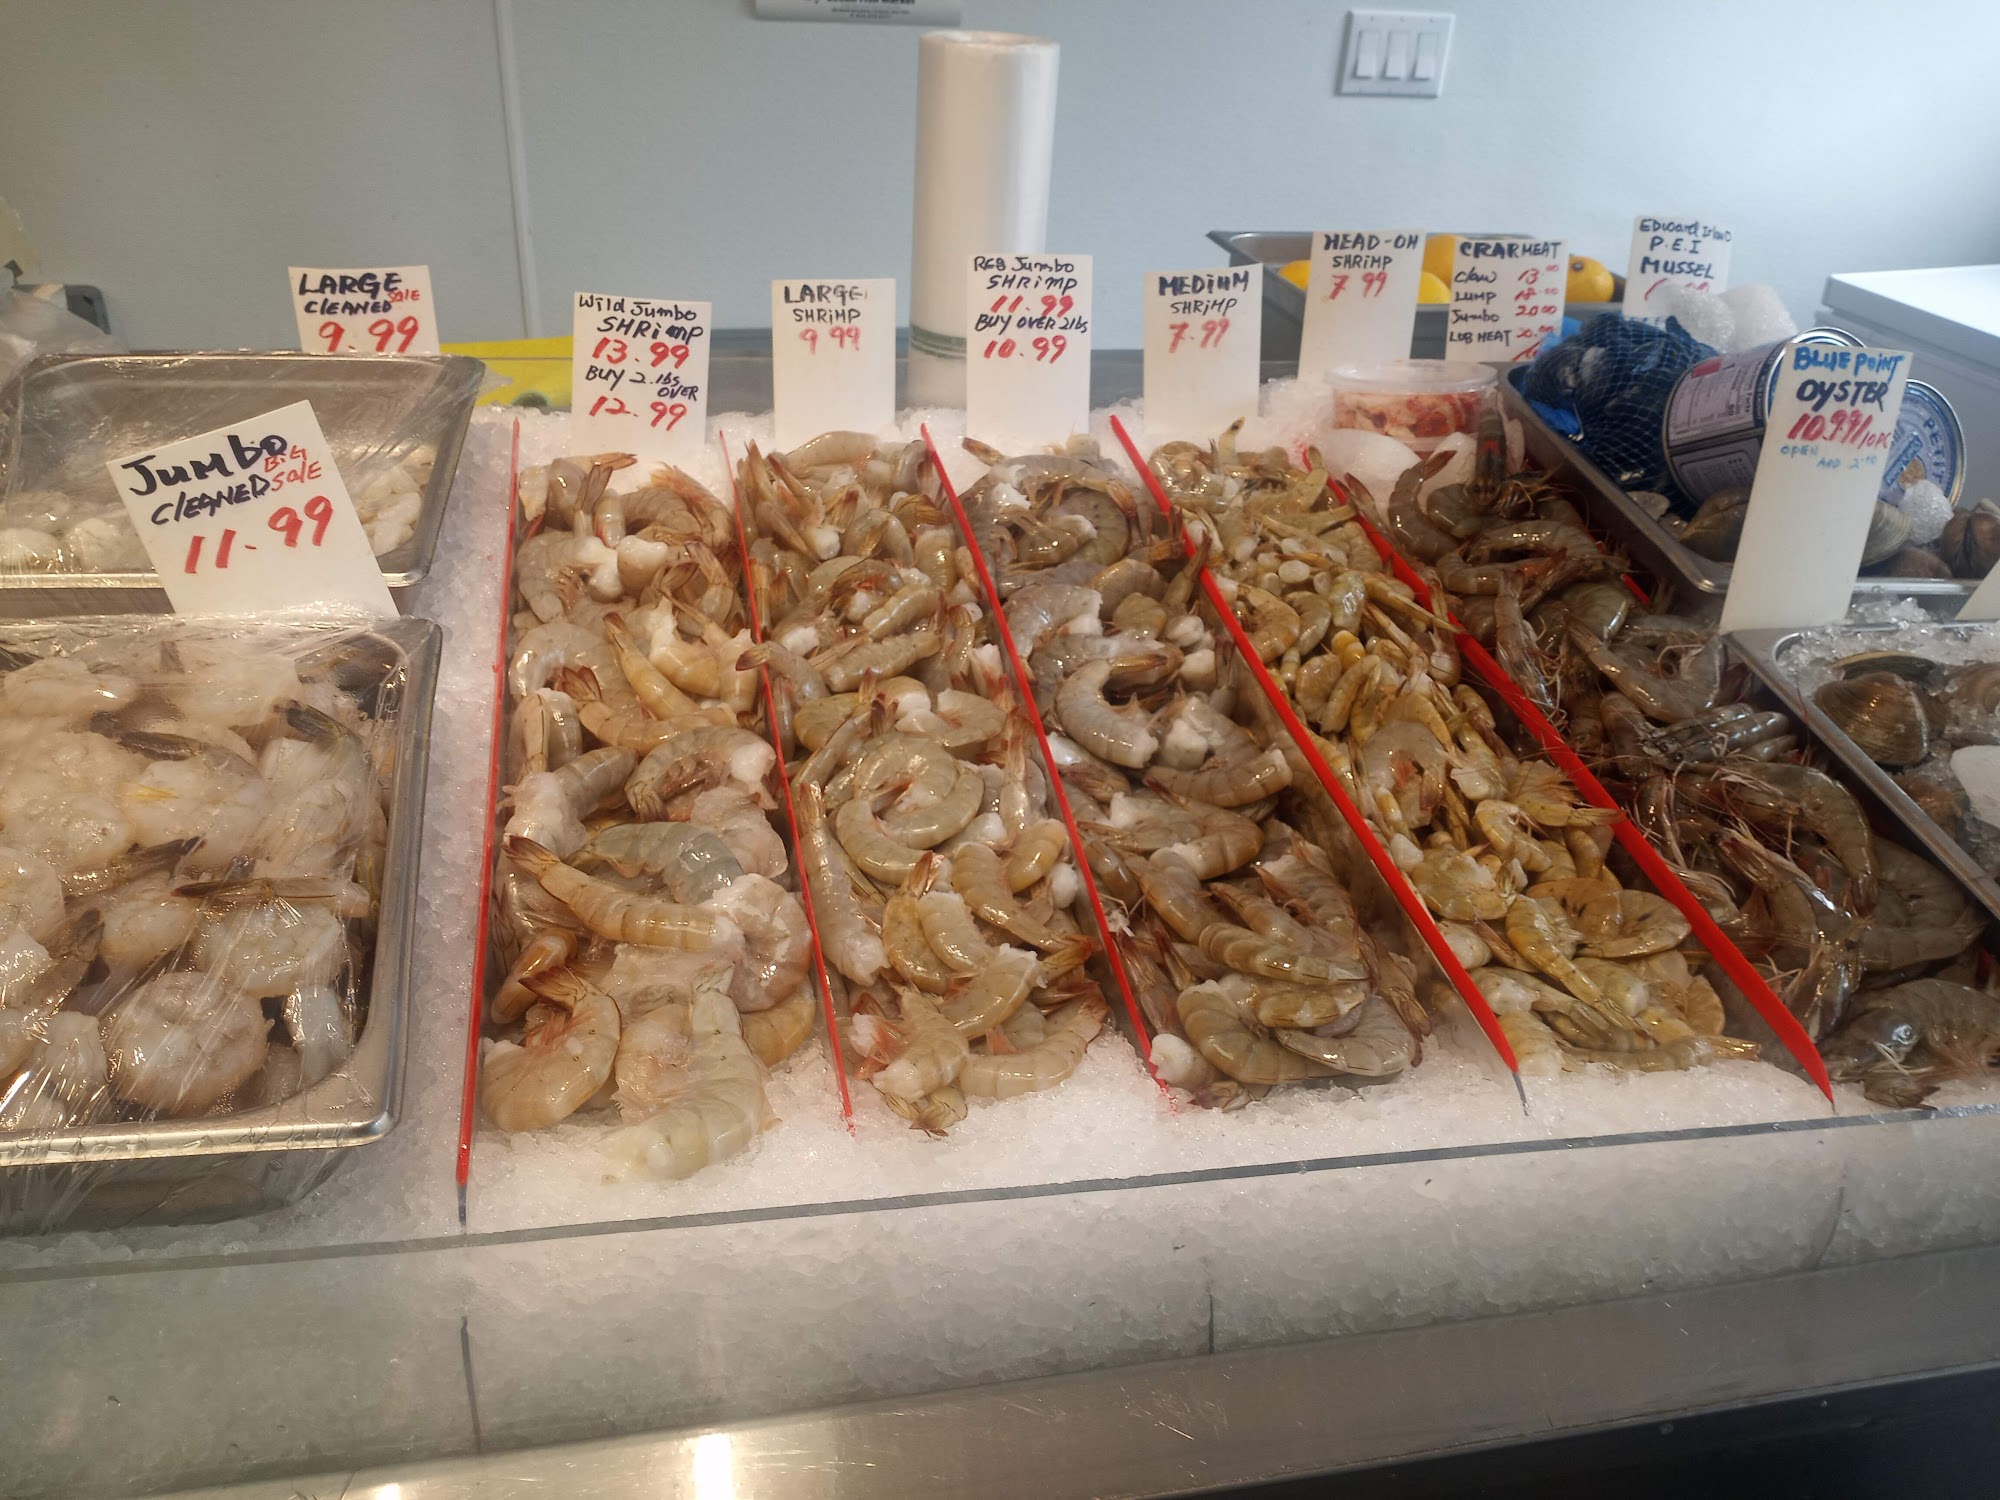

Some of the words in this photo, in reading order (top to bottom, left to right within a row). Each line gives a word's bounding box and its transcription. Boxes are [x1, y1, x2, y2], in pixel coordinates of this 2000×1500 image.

[1011, 257, 1074, 273] Jumbo
[1640, 256, 1714, 279] MUSSEL
[299, 273, 402, 299] LARGE
[784, 284, 864, 306] LARGE
[631, 302, 697, 321] Jumbo
[990, 295, 1074, 318] 11.99
[319, 316, 418, 352] 9.99
[974, 314, 1012, 335] BUY
[1017, 316, 1056, 331] OVER
[592, 337, 689, 369] 13.99
[984, 335, 1067, 364] 10.99
[1793, 346, 1851, 371] BLUE
[585, 365, 625, 391] BUY
[657, 385, 699, 402] OVER
[1796, 379, 1889, 412] OYSTER
[589, 396, 687, 431] 12.99
